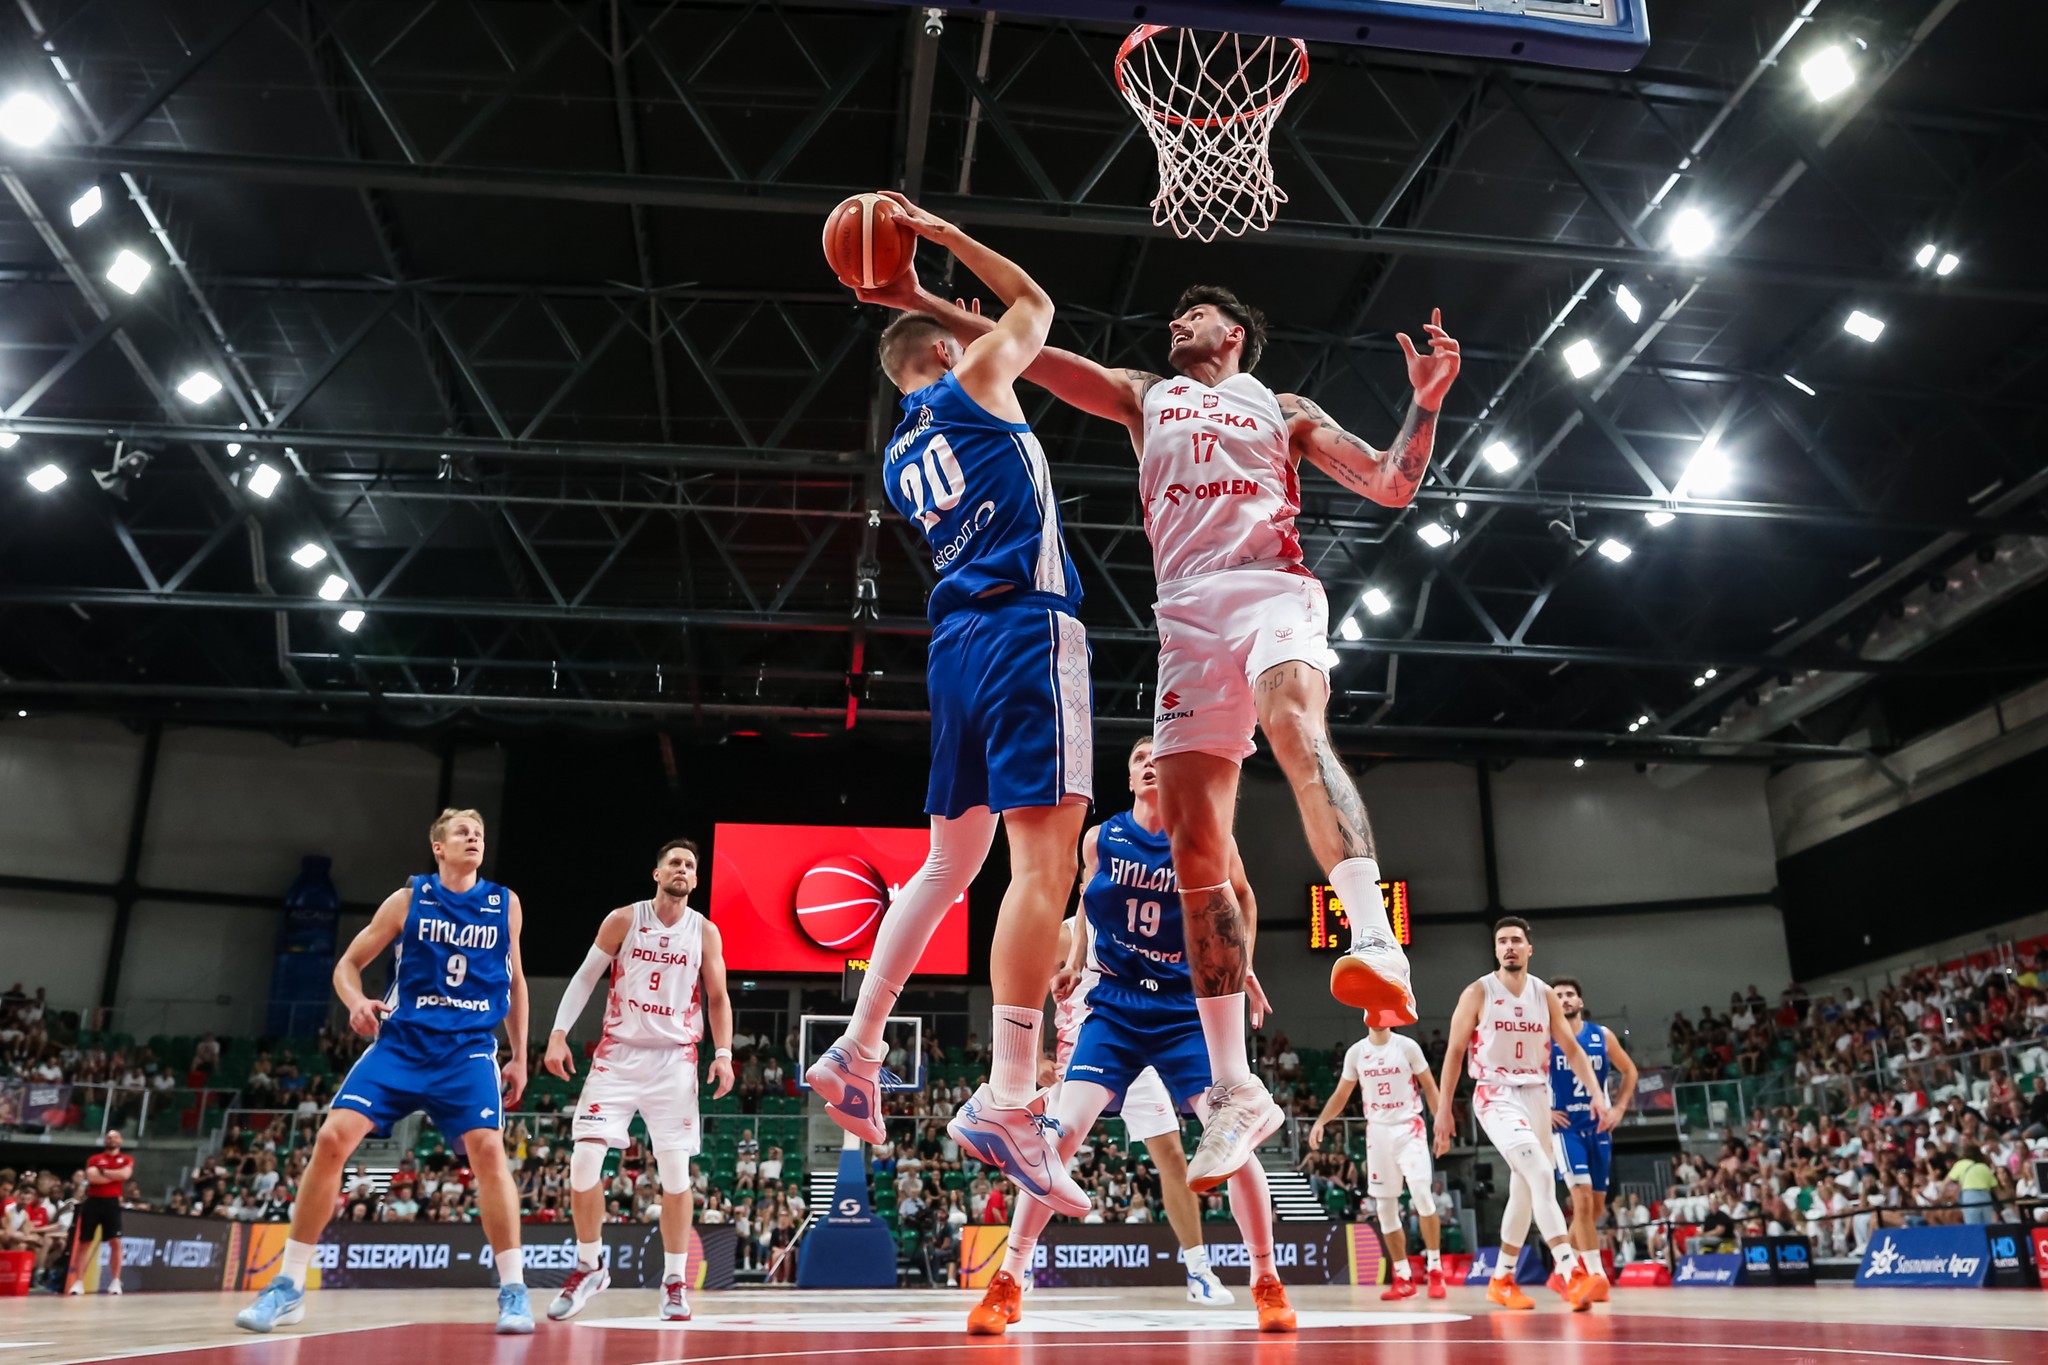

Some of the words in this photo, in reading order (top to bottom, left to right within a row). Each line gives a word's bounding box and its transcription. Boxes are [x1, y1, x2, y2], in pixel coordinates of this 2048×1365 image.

[1167, 386, 1190, 395] 4F
[1159, 407, 1258, 431] POLSKA
[1192, 432, 1218, 464] 17
[900, 433, 966, 535] 20
[1195, 480, 1258, 500] ORLEN
[1110, 857, 1178, 893] FINLAN
[1126, 898, 1161, 938] 19
[418, 918, 498, 949] FINLAND
[632, 948, 687, 966] POLSKA
[446, 953, 467, 987] 9
[649, 972, 661, 991] 9
[1495, 1021, 1543, 1033] POLSKA
[1515, 1041, 1523, 1059] 0
[1364, 1066, 1401, 1078] POLSKA
[1377, 1082, 1391, 1096] 23
[310, 1243, 341, 1269] 28
[346, 1243, 450, 1269] SIERPNIA
[478, 1244, 493, 1269] 4
[617, 1244, 633, 1269] 2
[1055, 1244, 1149, 1269] SIERPNIA
[1303, 1244, 1318, 1266] 2
